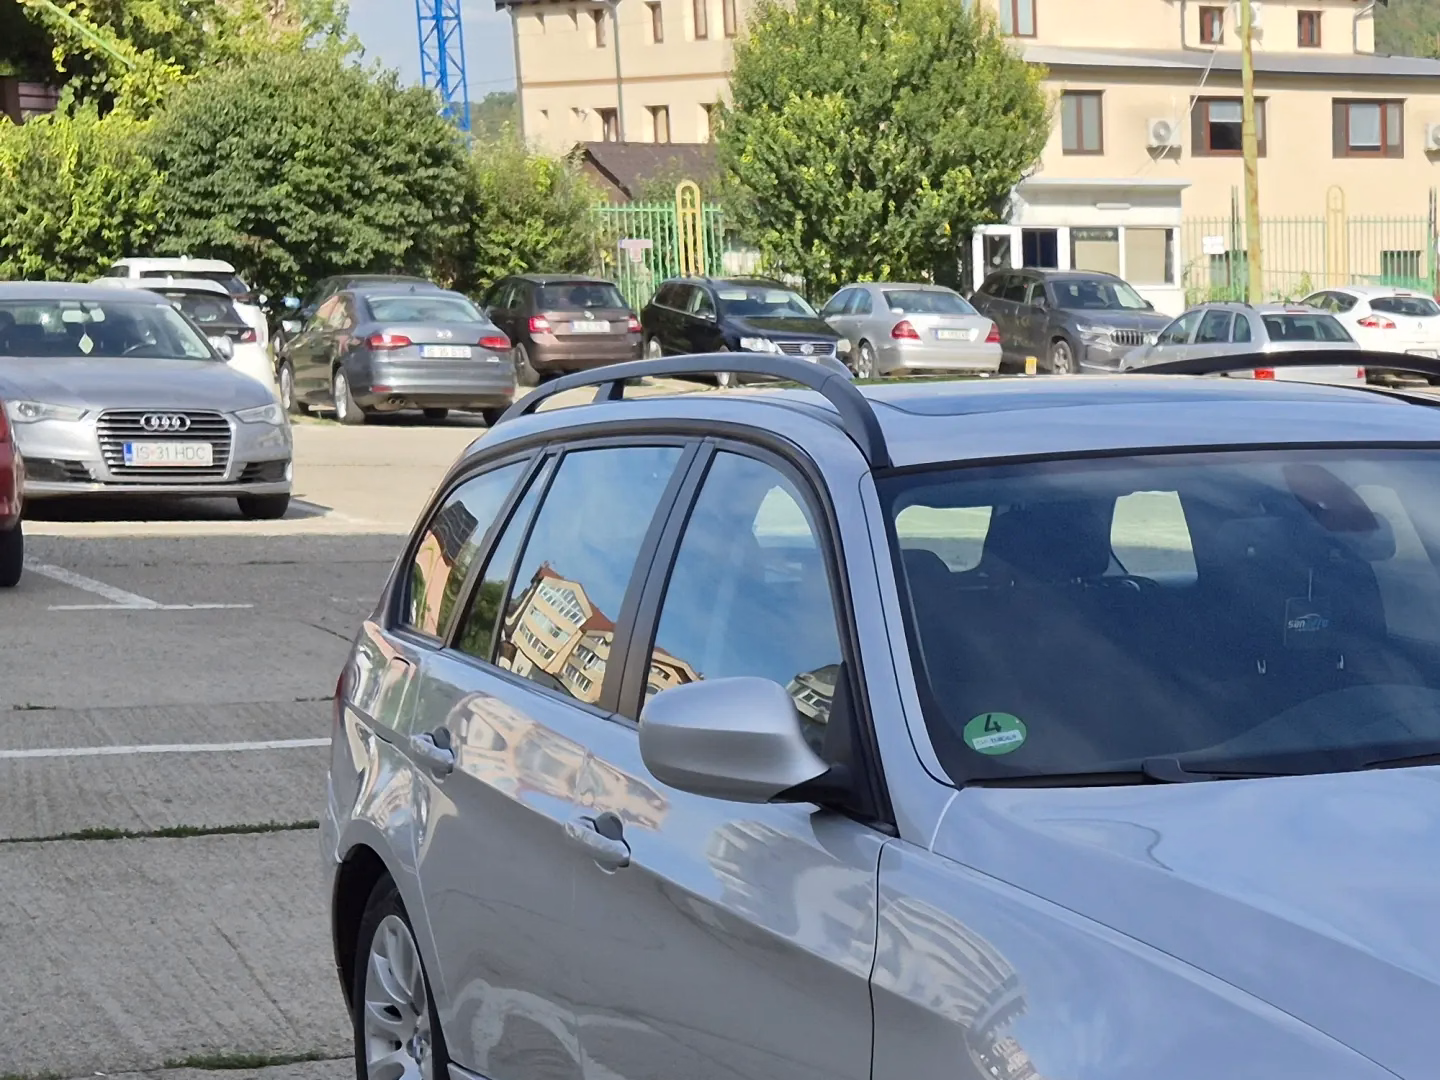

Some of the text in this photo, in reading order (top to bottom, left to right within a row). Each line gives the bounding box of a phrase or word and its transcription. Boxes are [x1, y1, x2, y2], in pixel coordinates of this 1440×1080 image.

[136, 445, 206, 460] IS 31 HDC
[984, 713, 1002, 733] 4
